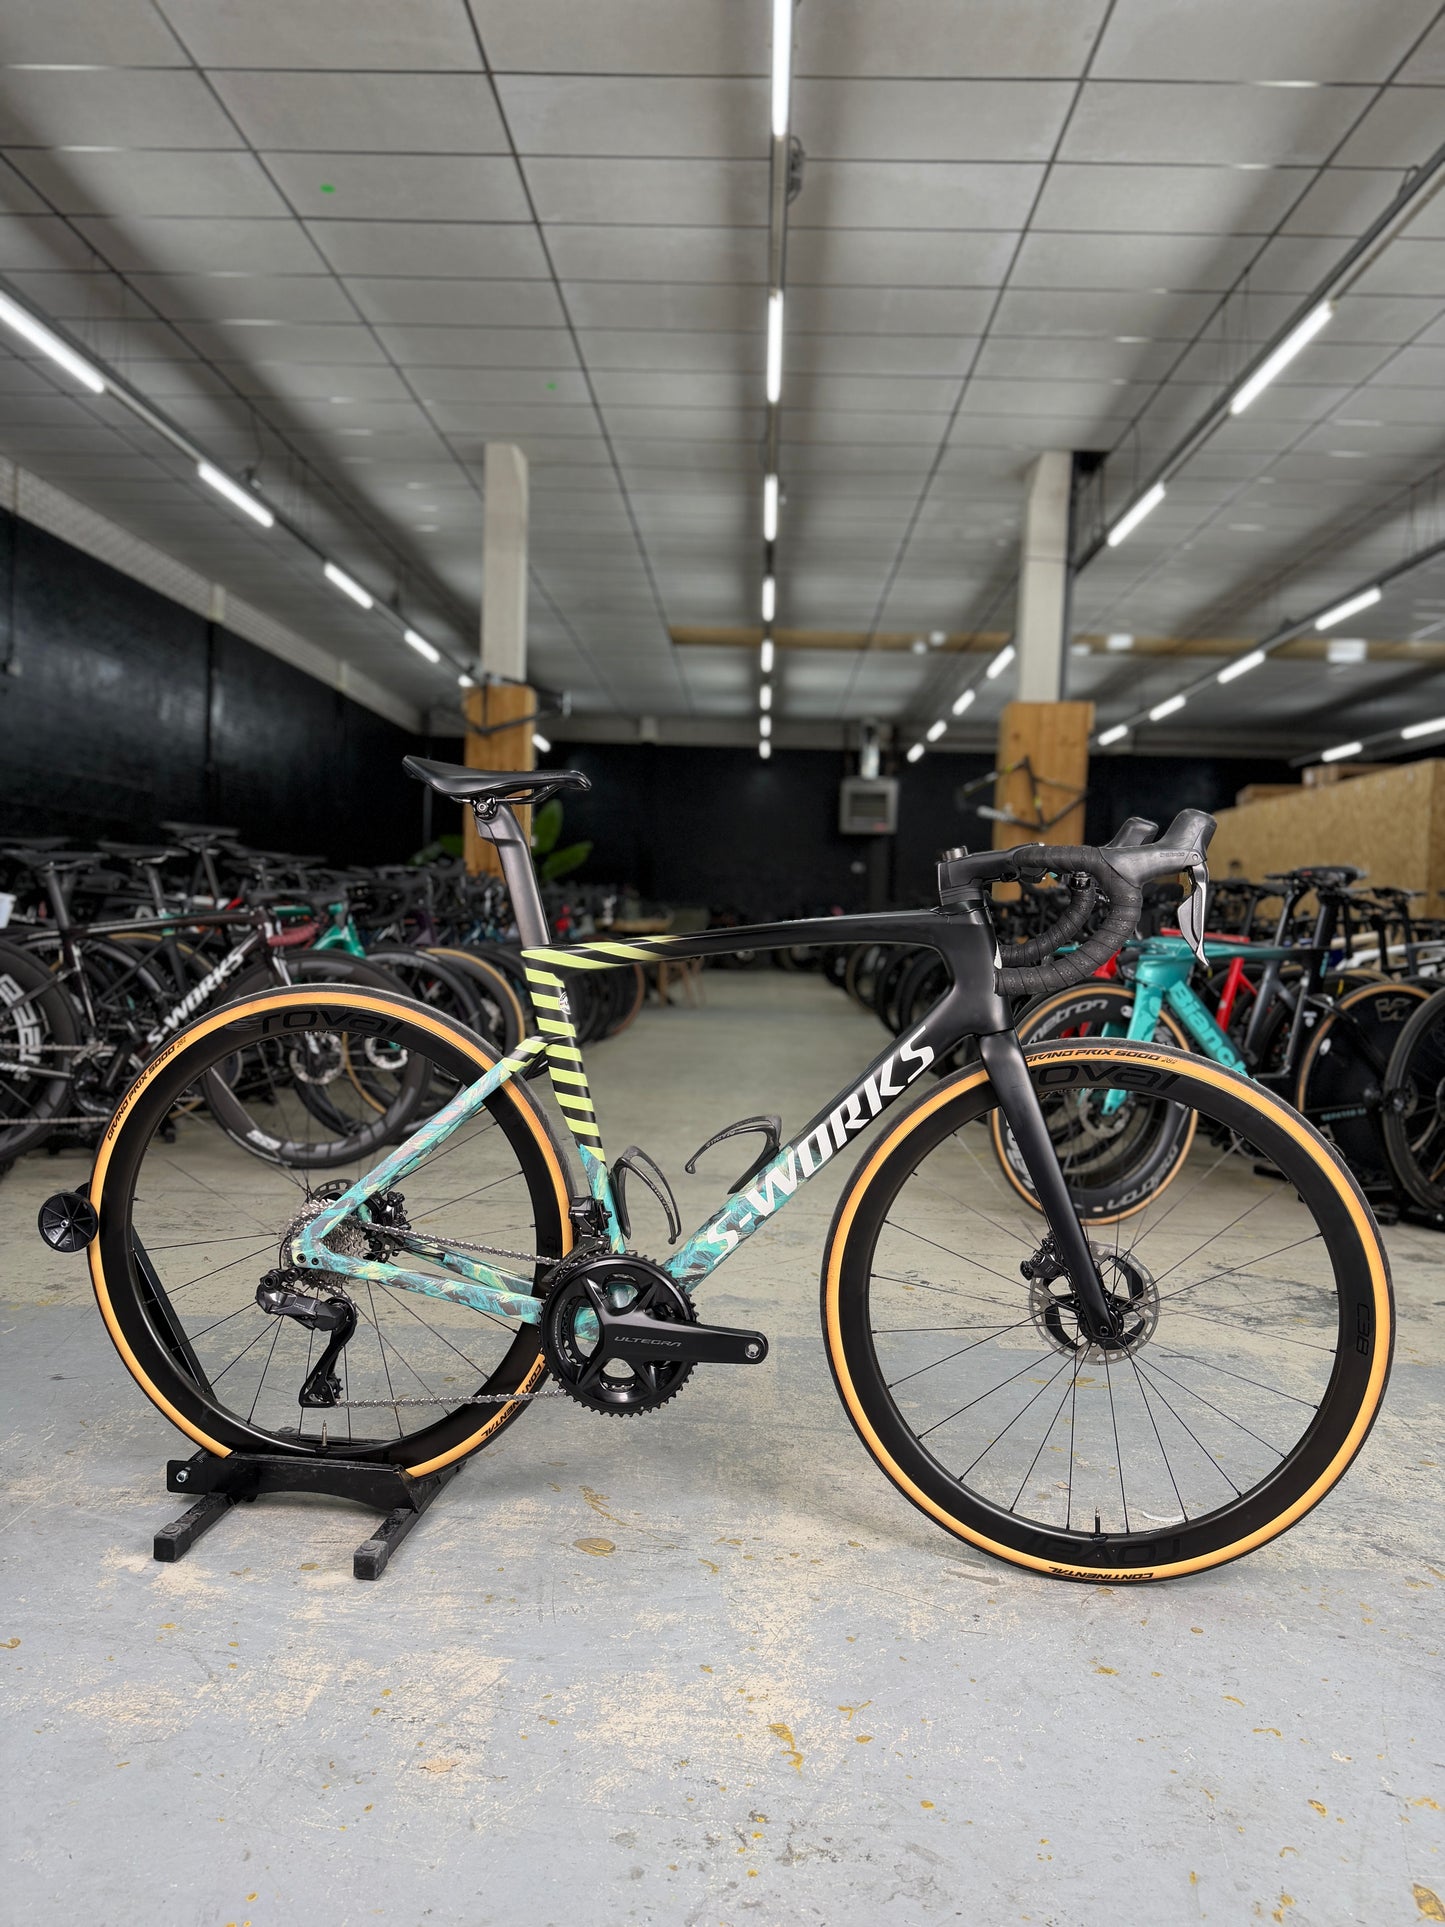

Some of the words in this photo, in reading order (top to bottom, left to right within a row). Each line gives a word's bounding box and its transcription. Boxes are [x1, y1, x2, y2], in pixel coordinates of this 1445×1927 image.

[262, 1010, 405, 1037] roval
[1025, 1050, 1074, 1063] GRAND
[1114, 1049, 1161, 1061] 5000
[1030, 1064, 1181, 1091] oval
[107, 1098, 129, 1141] GRAND
[127, 1072, 148, 1101] PRIX
[148, 1045, 175, 1075] 5000
[707, 1025, 934, 1265] S-WORKS
[614, 1336, 682, 1347] ULTEGRA
[481, 1364, 542, 1437] CONNENTAL
[1049, 1566, 1154, 1580] CONTINENTAL
